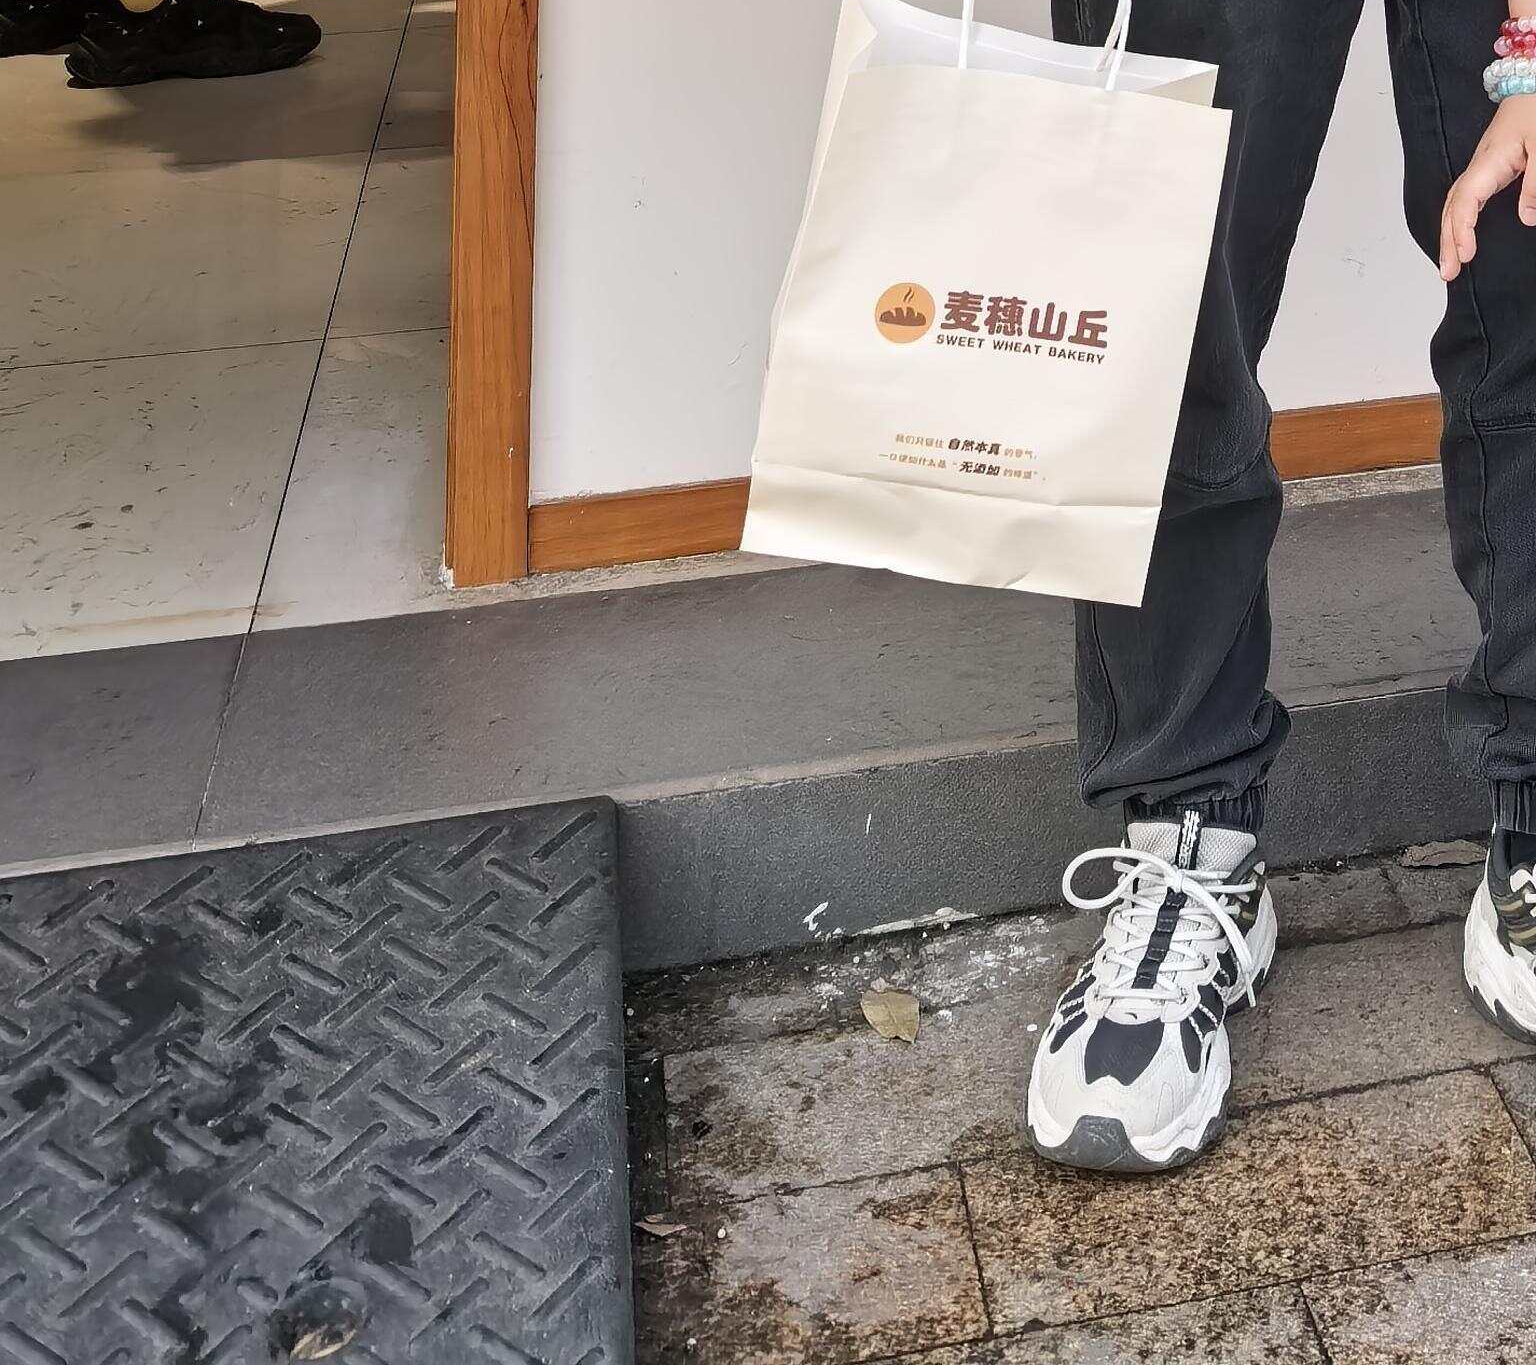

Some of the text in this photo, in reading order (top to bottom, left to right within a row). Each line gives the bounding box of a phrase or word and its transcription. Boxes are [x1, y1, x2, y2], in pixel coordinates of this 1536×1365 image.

[940, 290, 1108, 349] 麦穗山丘
[936, 333, 1105, 365] SWEET WHEAT BAKERY
